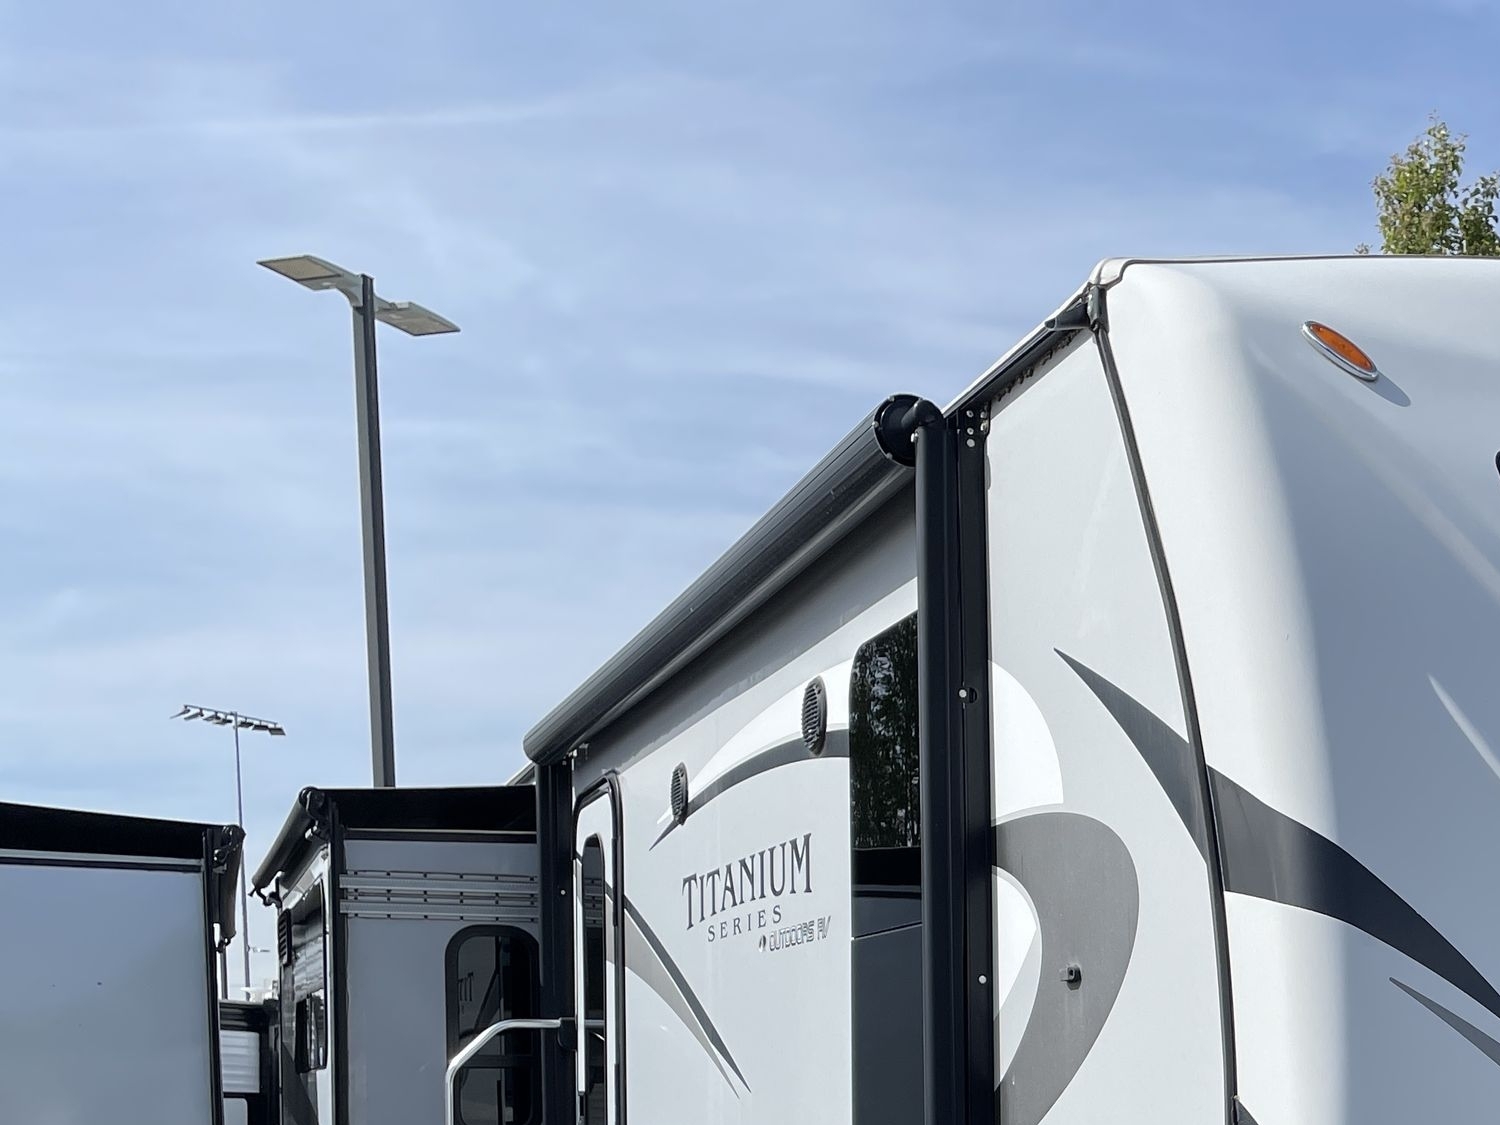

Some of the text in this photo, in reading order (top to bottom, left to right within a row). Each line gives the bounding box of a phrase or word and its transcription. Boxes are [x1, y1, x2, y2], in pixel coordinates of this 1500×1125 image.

[681, 832, 813, 931] TITANIUM
[707, 904, 783, 943] SERIES
[768, 915, 832, 952] OUTDOORS RV
